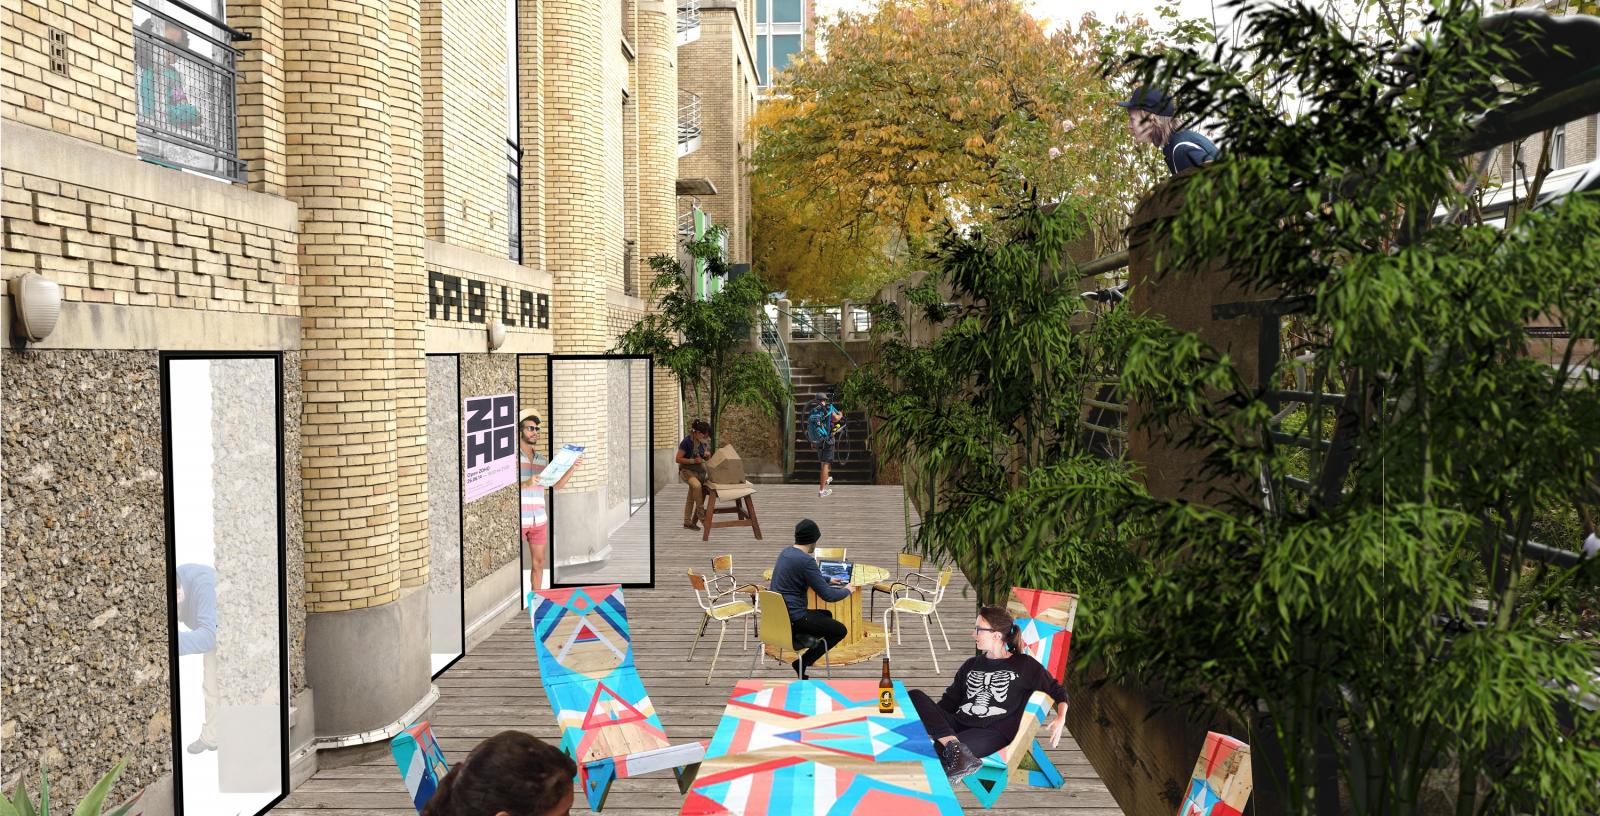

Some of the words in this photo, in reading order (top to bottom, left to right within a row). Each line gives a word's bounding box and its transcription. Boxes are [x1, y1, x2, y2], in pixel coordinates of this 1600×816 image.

[429, 271, 485, 323] FAB
[502, 286, 549, 329] LAB
[467, 396, 514, 434] ZO
[467, 426, 514, 469] HO
